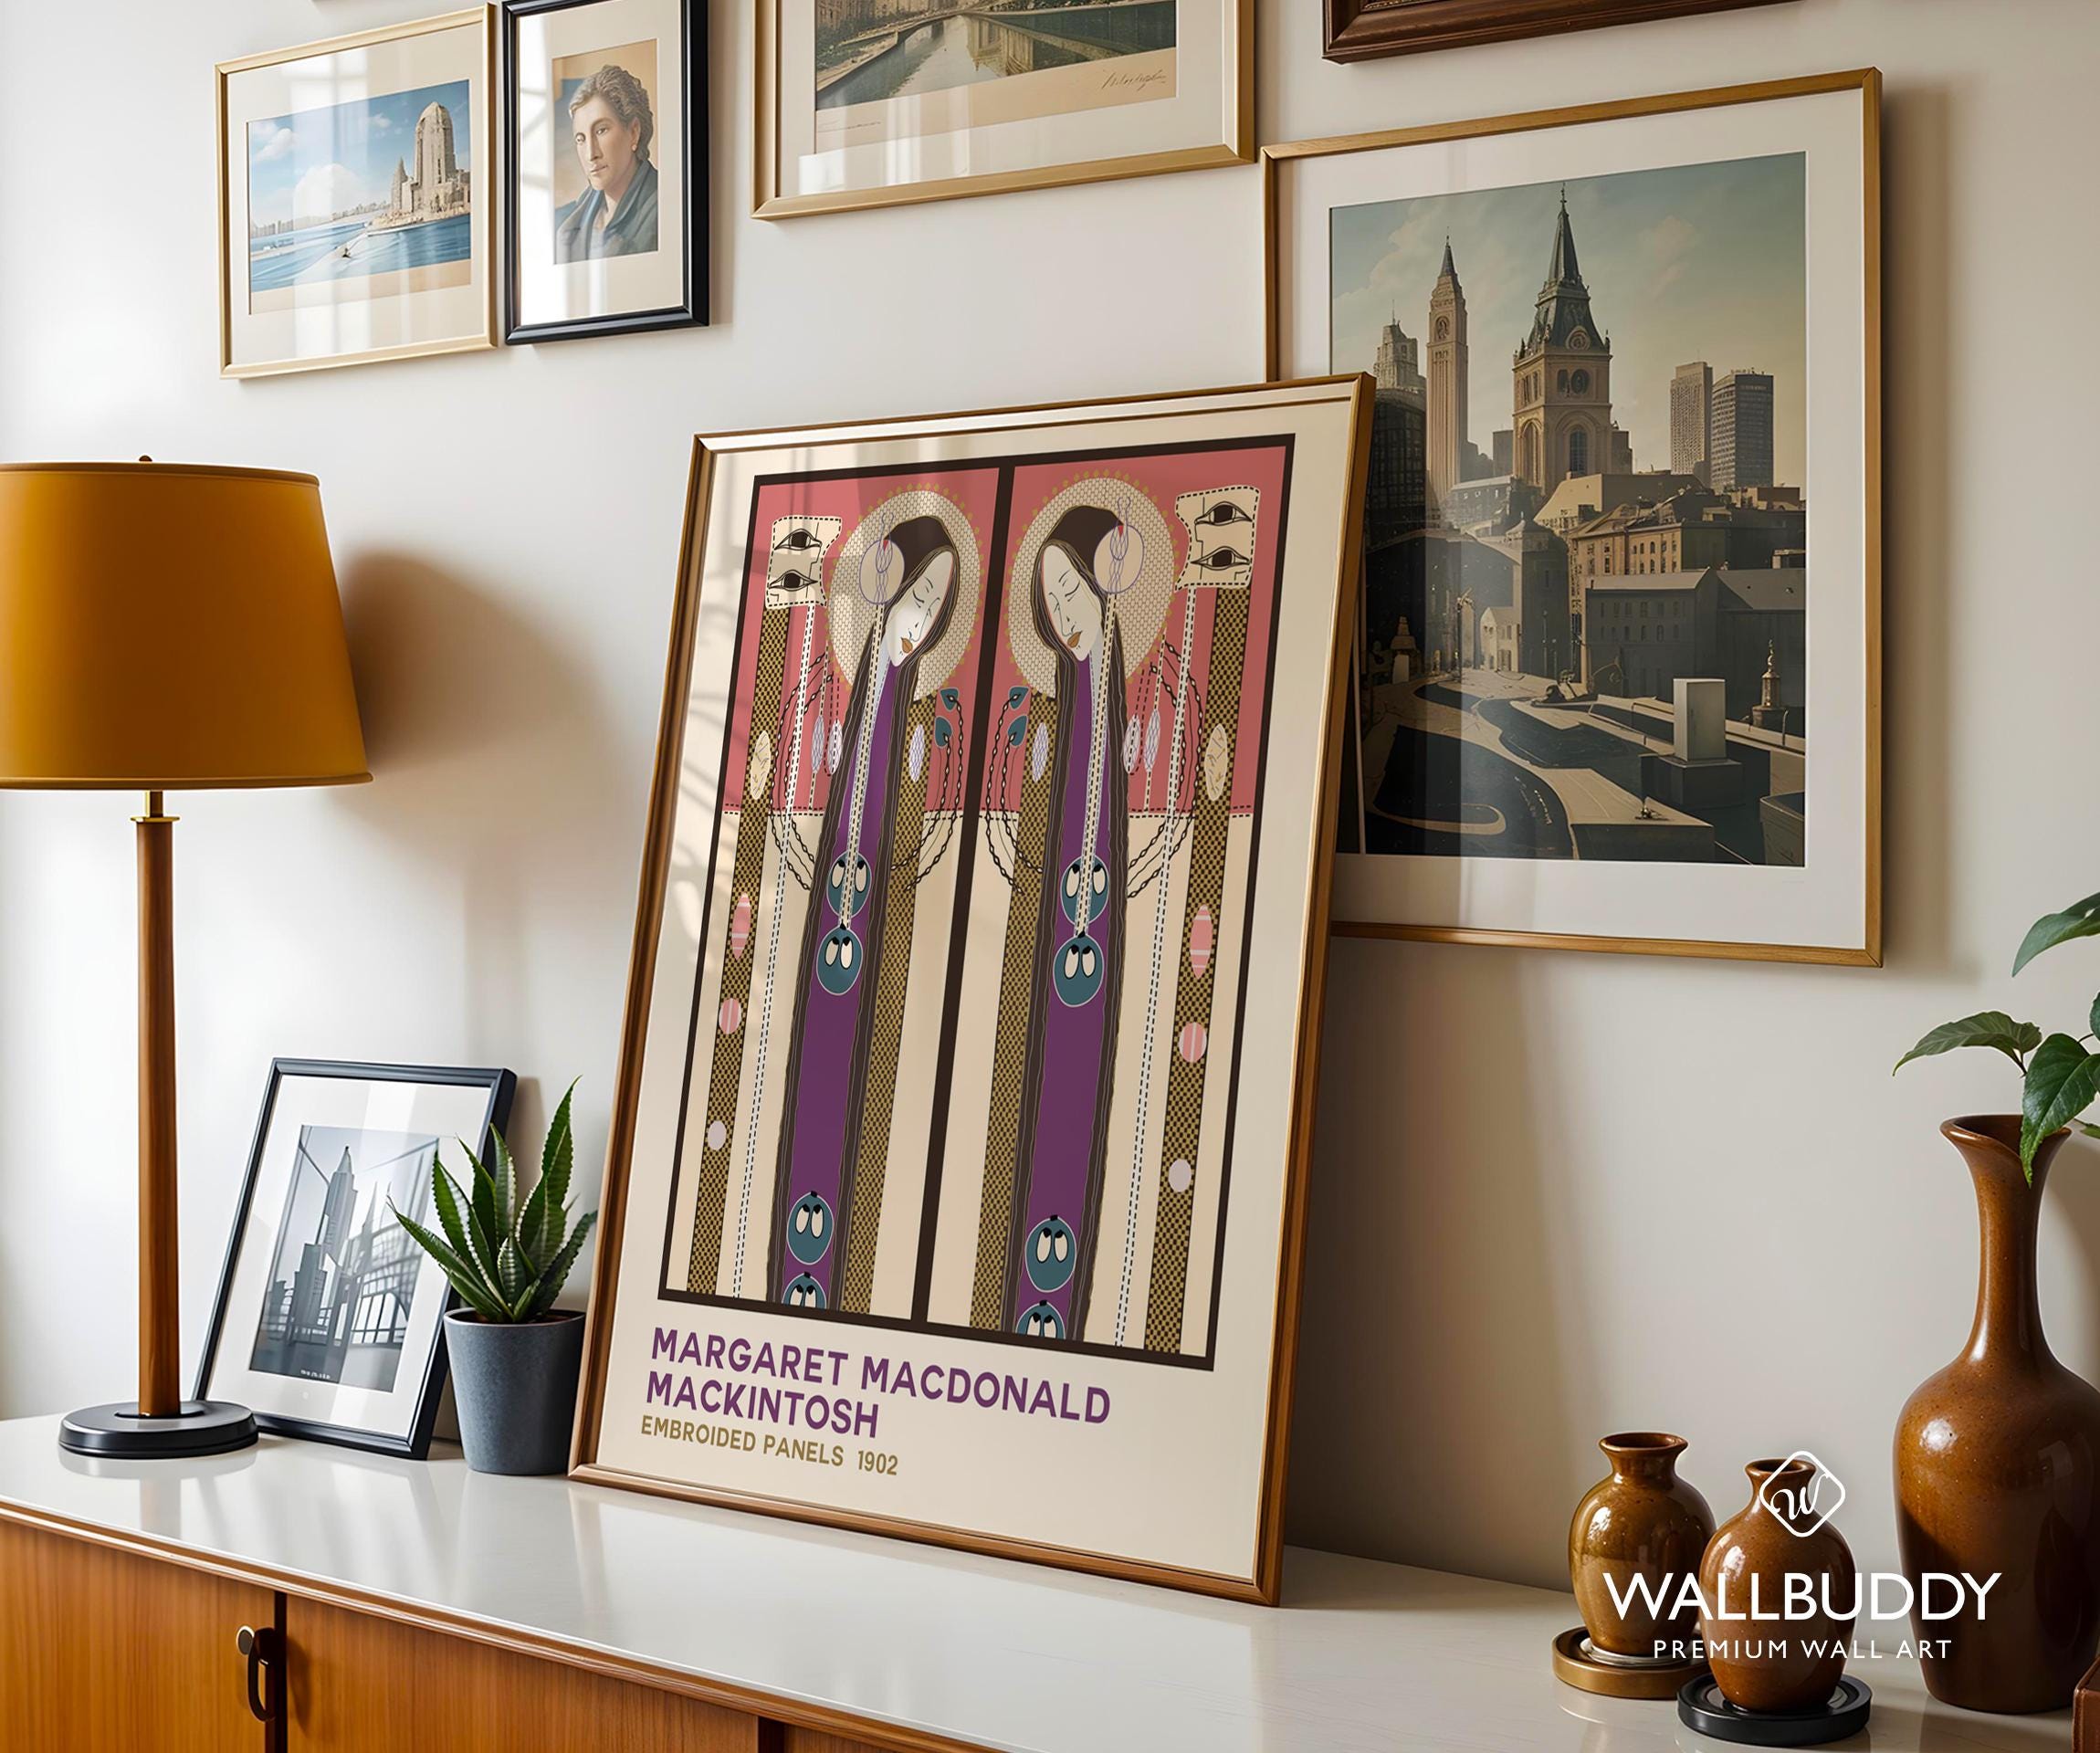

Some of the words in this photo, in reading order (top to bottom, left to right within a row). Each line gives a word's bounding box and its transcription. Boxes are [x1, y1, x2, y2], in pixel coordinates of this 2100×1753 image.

[646, 1370, 879, 1439] MACKINTOSH
[651, 1327, 849, 1387] MARGARET
[860, 1355, 1111, 1424] MACDONALD
[640, 1414, 757, 1453] EMBROIDED
[761, 1433, 845, 1467] PANELS
[856, 1450, 898, 1477] 1902
